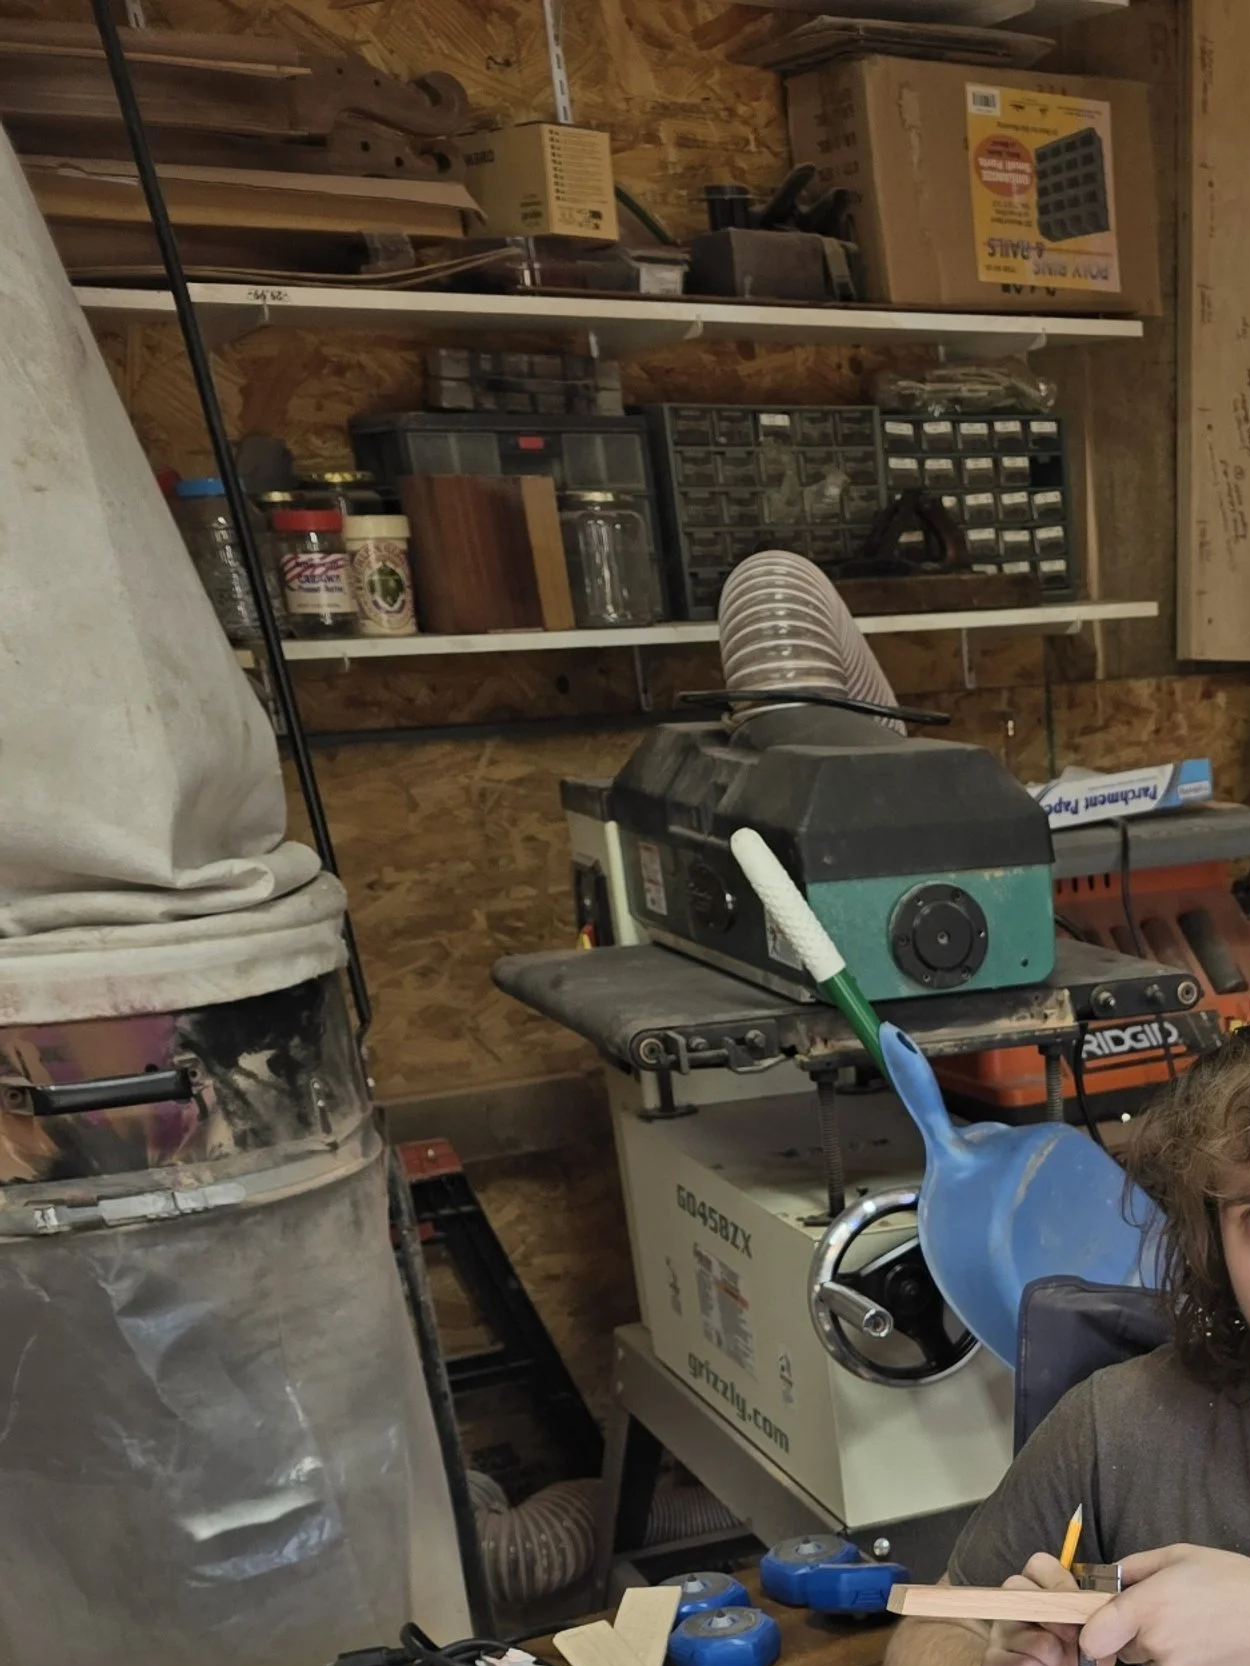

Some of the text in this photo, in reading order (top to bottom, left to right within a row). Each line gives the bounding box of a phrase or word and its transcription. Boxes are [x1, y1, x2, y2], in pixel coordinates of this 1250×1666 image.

[1044, 798, 1080, 816] Pape
[1083, 783, 1158, 812] Parchment
[1081, 1020, 1180, 1059] RIDGID
[687, 1351, 790, 1454] grizzly.com
